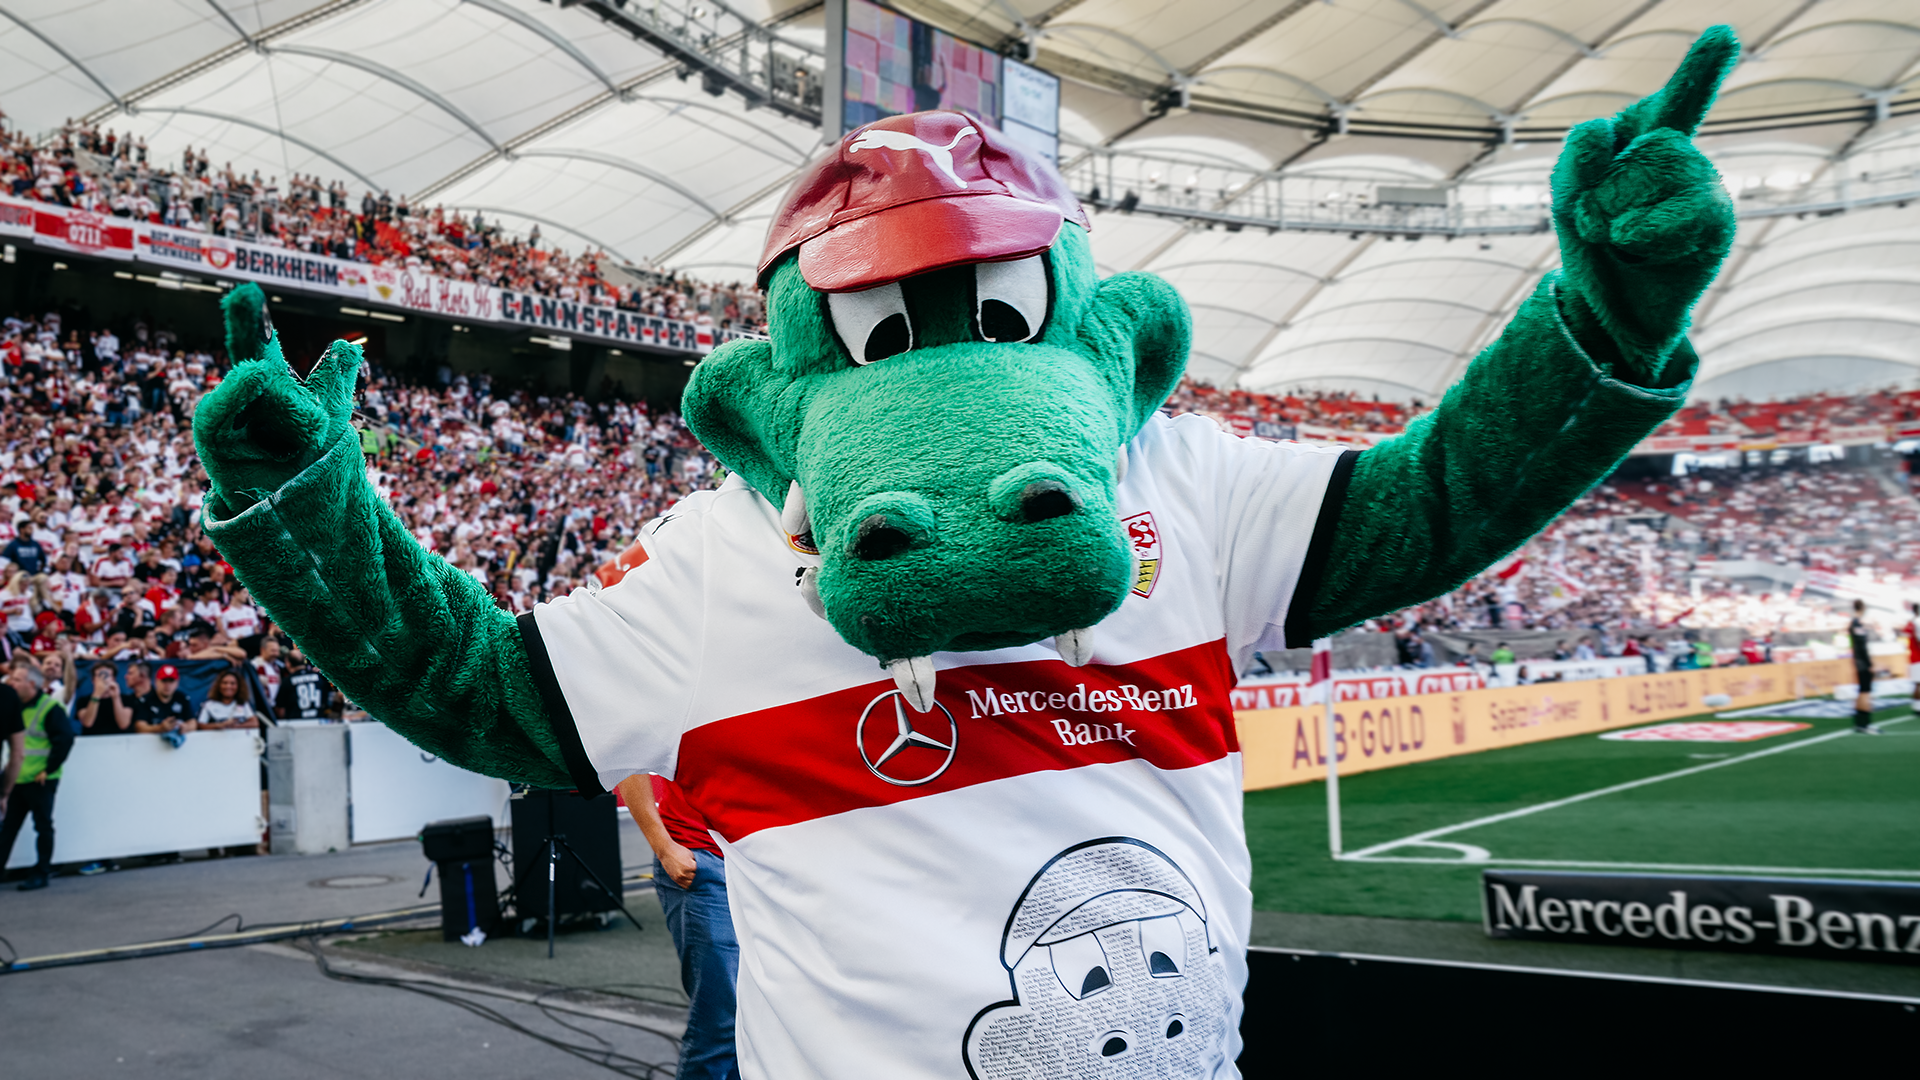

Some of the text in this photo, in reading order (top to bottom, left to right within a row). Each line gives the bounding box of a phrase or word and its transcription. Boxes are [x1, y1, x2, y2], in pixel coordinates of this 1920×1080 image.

[69, 224, 101, 246] 0711
[235, 247, 338, 286] BERKHEIM
[401, 272, 492, 319] Red Hots 96
[502, 291, 697, 350] CANNSTATTER
[296, 682, 322, 709] 84
[965, 683, 1198, 719] Mercedes-Benz
[1050, 718, 1137, 747] Bank
